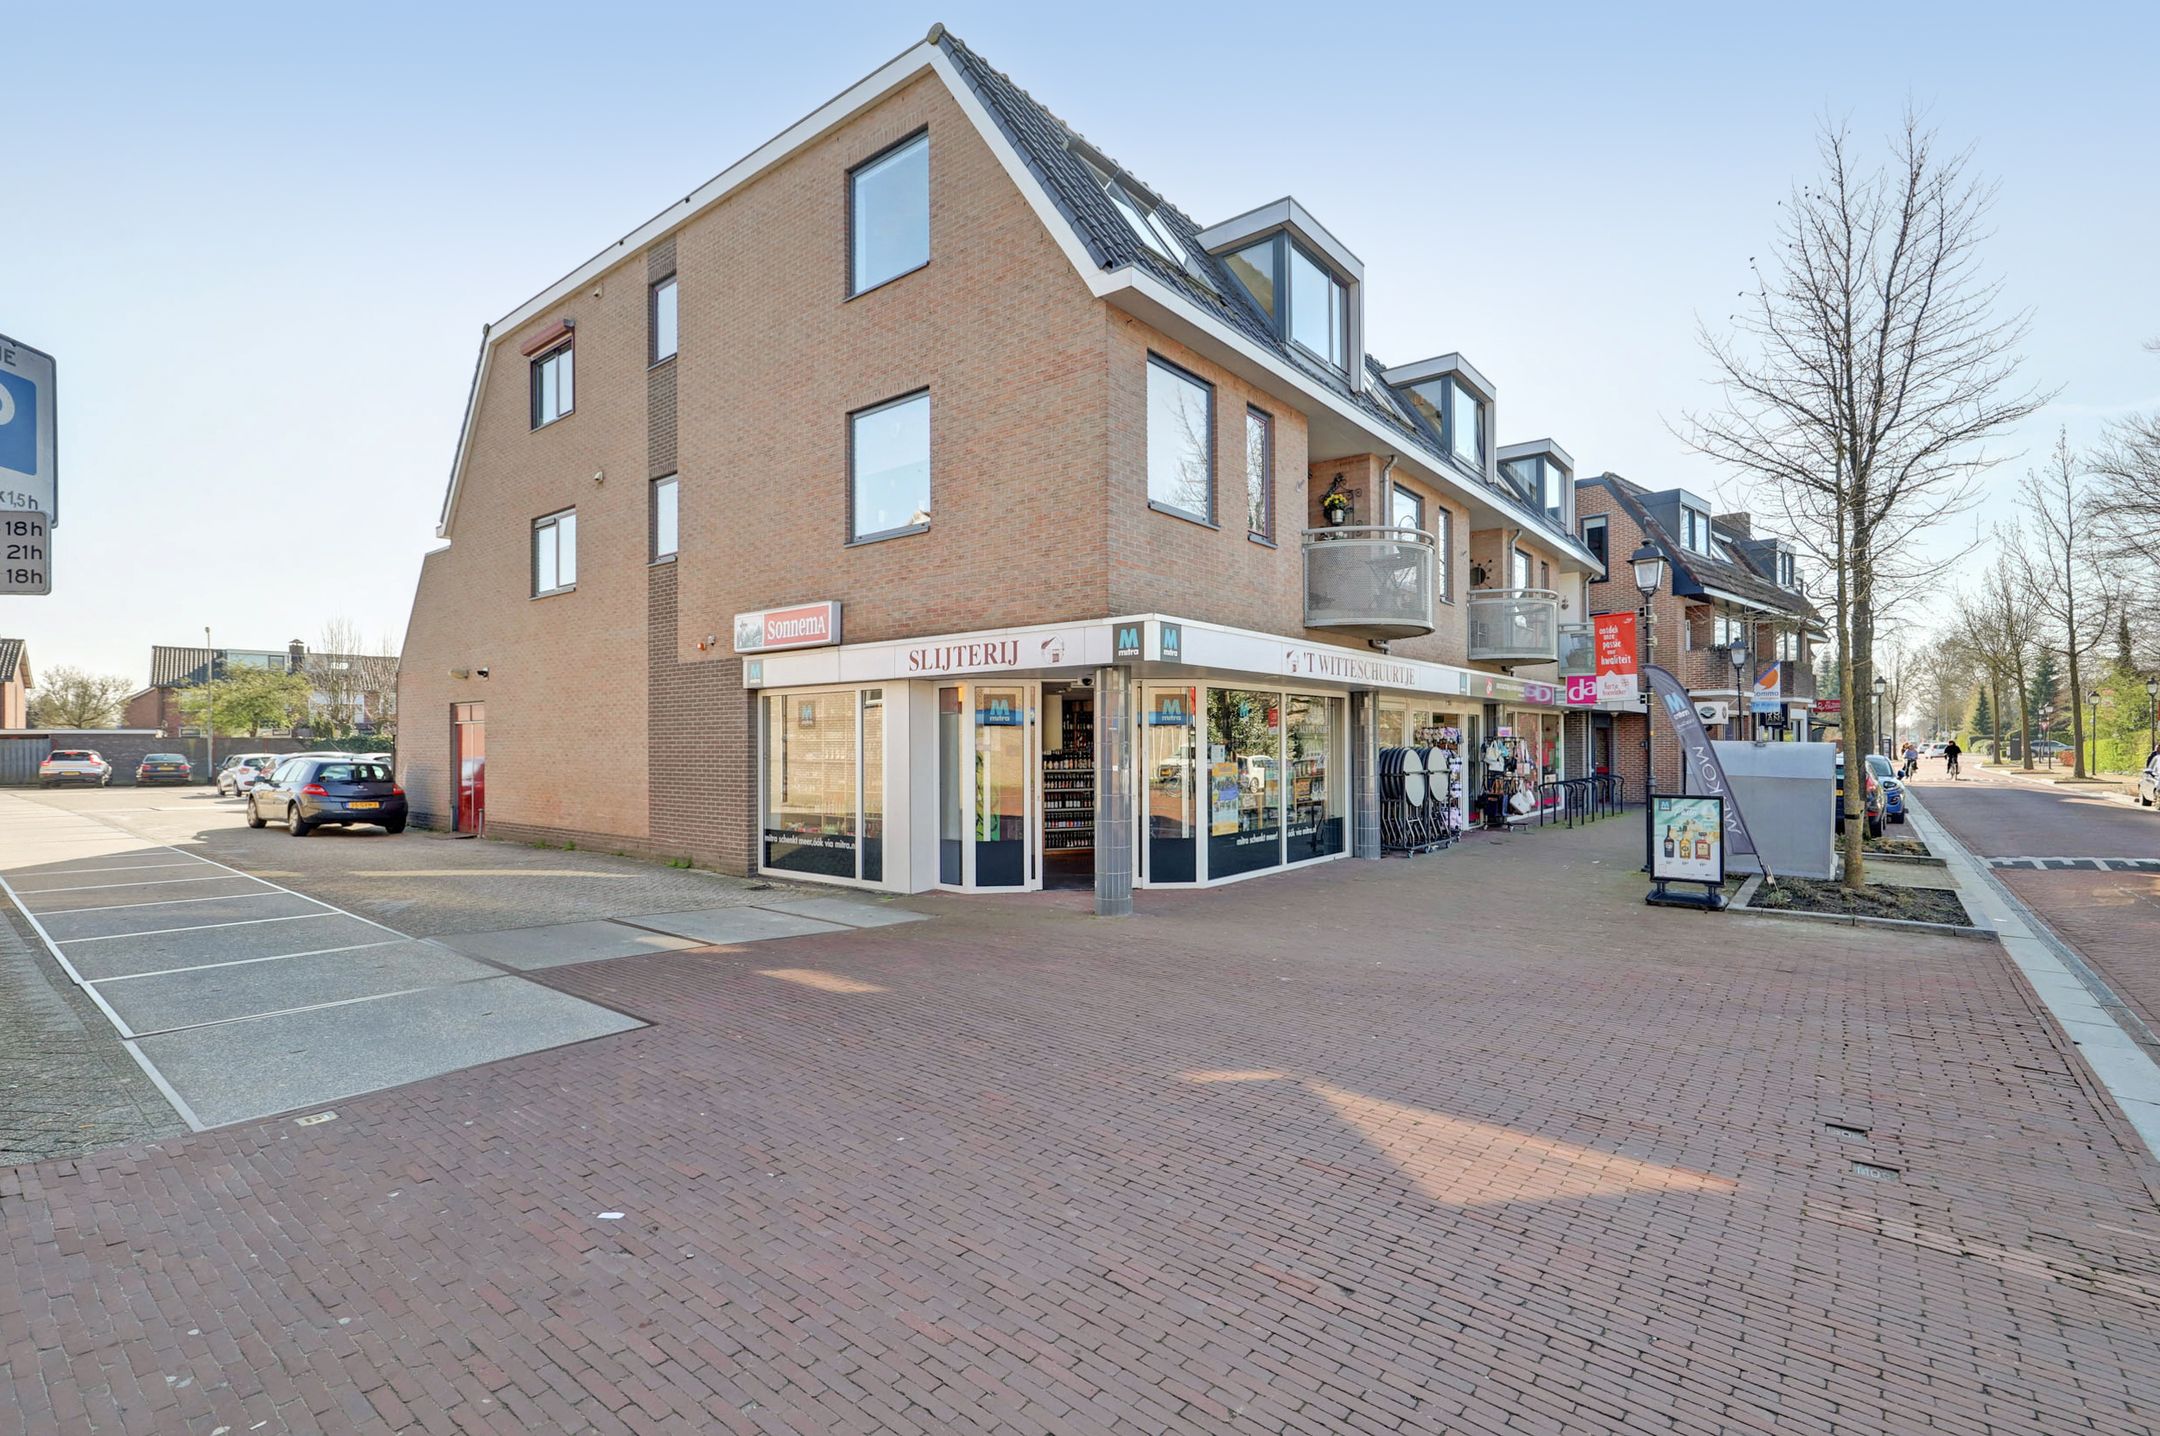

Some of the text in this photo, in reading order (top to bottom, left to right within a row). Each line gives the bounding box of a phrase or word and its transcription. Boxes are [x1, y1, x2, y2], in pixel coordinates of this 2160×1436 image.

[5, 521, 42, 536] 18h
[7, 544, 42, 560] 21h
[6, 568, 42, 584] 18h
[909, 640, 1020, 672] SLIJTERIJ
[1118, 648, 1139, 657] mitra
[1163, 648, 1178, 657] mitra
[1319, 655, 1415, 686] WITTESCHUURTJE
[1692, 747, 1742, 834] WKOM
[765, 833, 778, 842] mitra
[779, 834, 798, 844] schenkt
[824, 838, 834, 848] via
